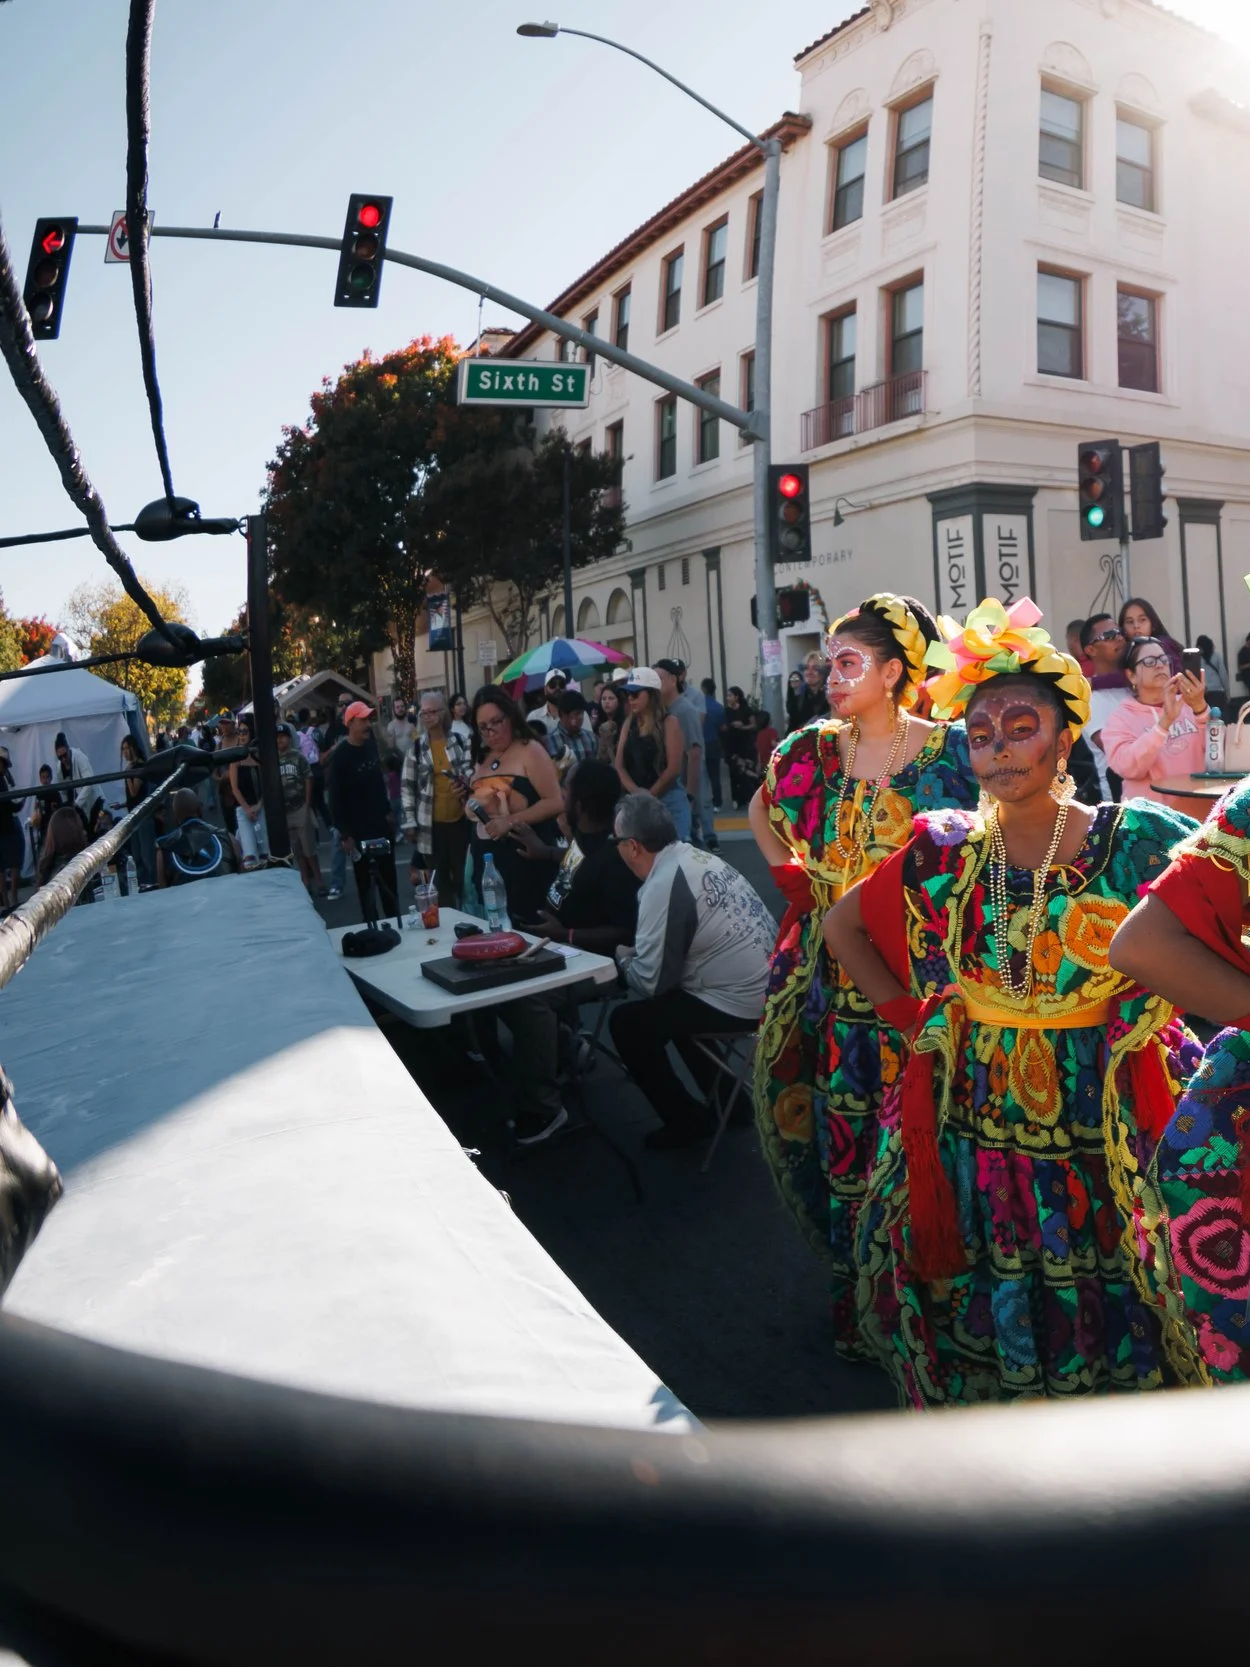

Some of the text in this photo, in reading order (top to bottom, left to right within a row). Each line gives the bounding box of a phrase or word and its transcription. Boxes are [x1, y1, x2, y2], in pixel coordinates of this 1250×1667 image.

[479, 371, 576, 392] Sixth St
[946, 528, 967, 609] MOTIF
[998, 525, 1020, 607] MOTIF
[1209, 727, 1219, 761] core
